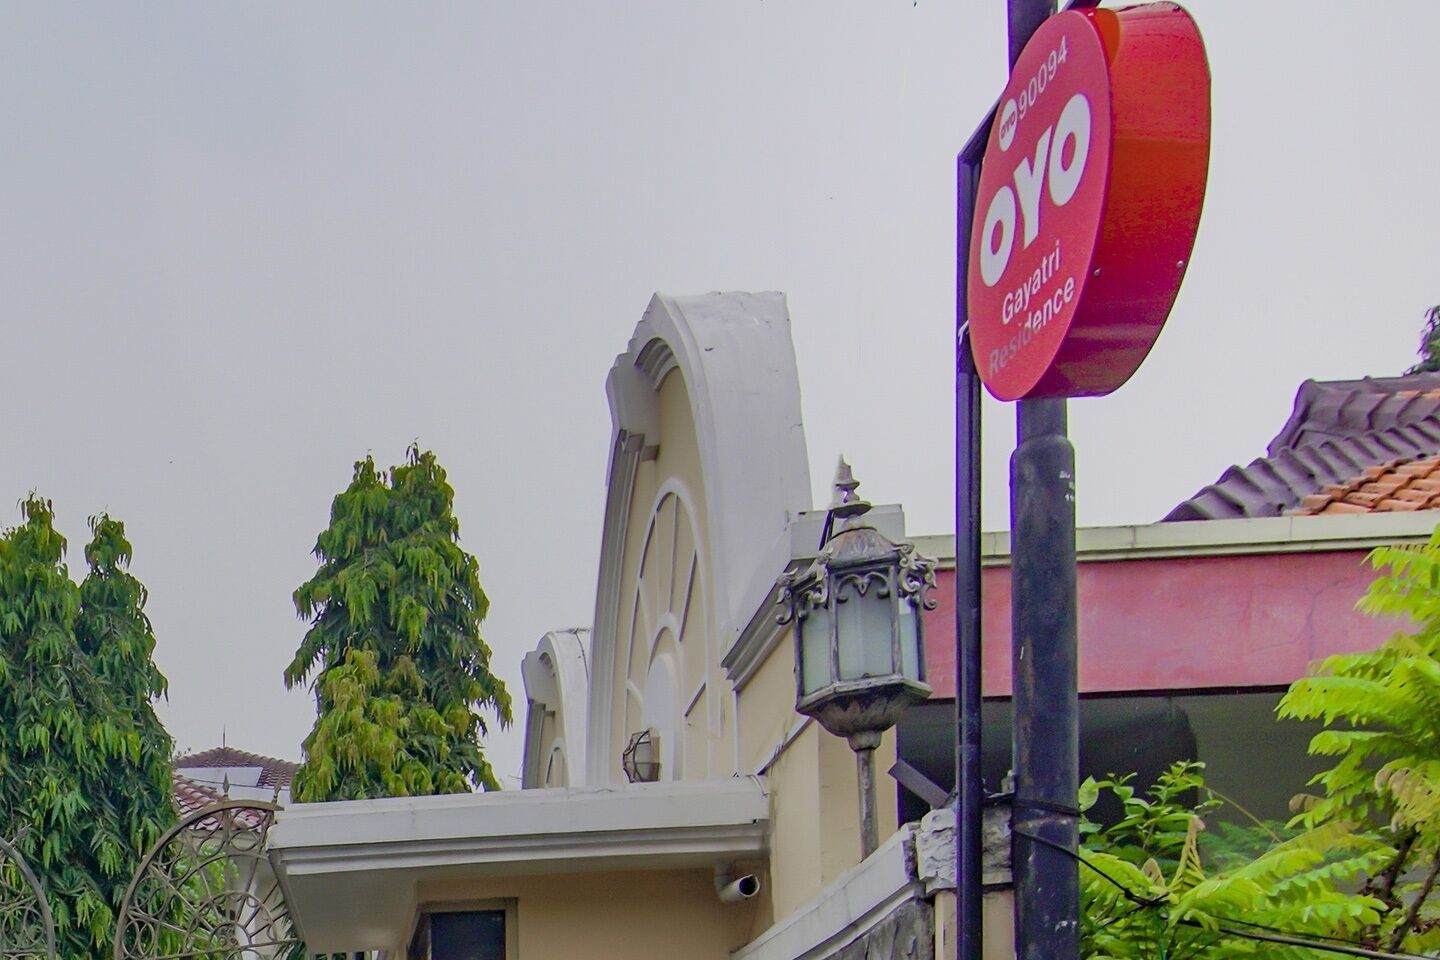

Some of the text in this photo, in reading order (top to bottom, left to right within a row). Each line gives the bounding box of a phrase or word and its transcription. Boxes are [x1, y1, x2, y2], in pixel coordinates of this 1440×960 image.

[1019, 35, 1068, 120] 90094
[980, 92, 1092, 287] OYO
[989, 276, 1075, 377] Residence
[1002, 240, 1060, 325] Gayatri
